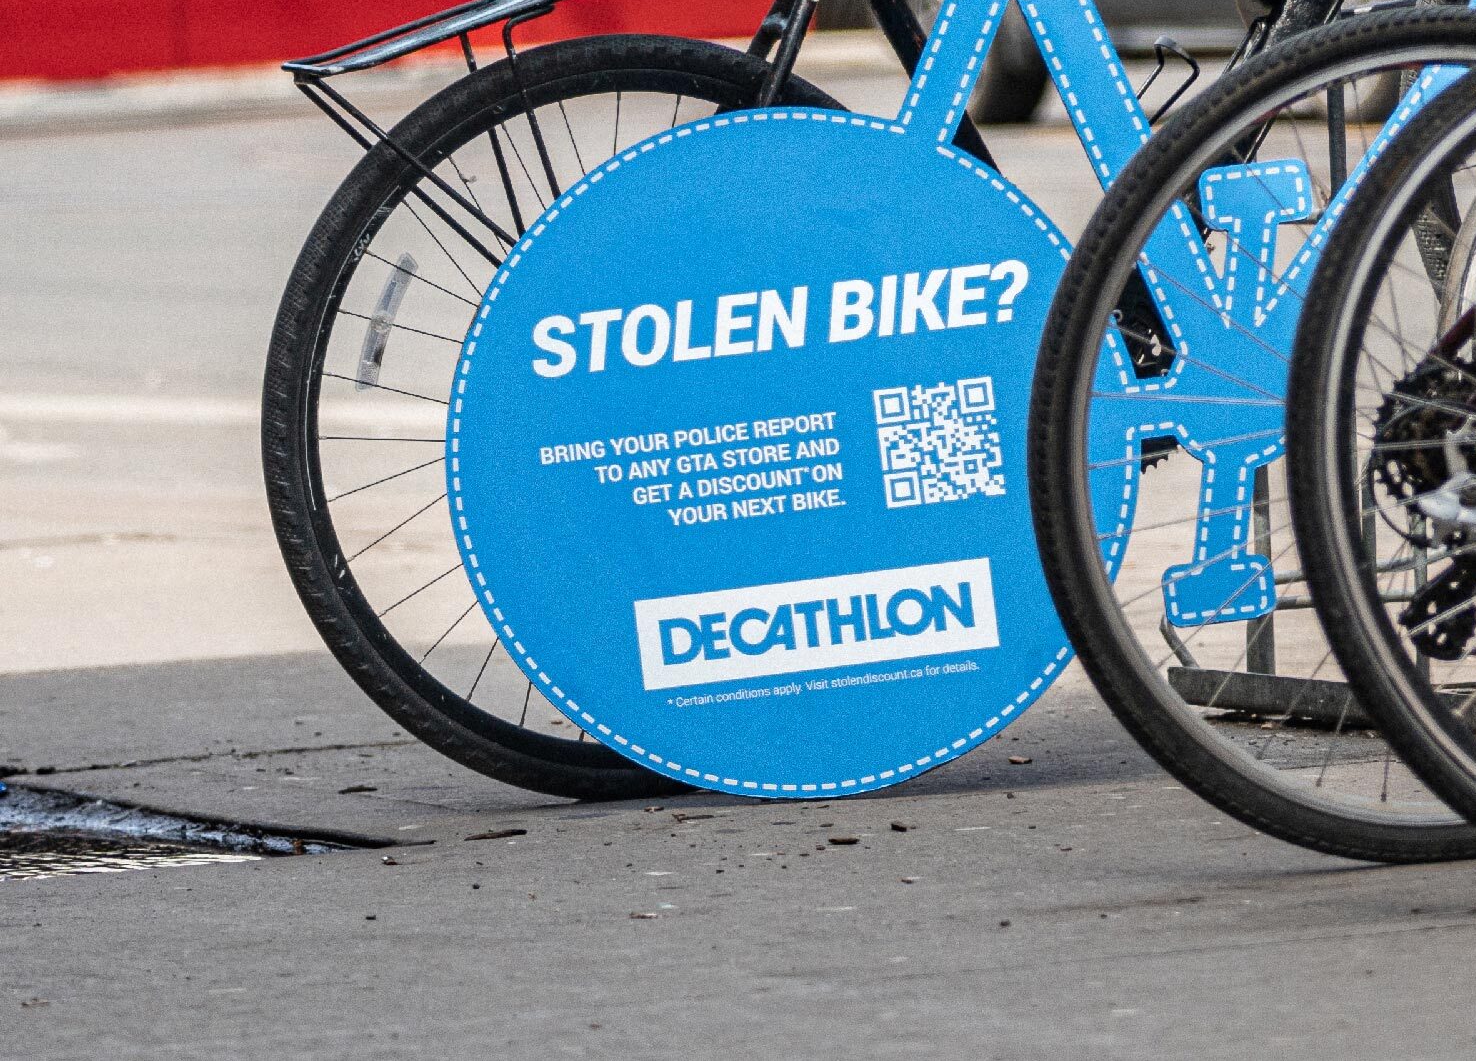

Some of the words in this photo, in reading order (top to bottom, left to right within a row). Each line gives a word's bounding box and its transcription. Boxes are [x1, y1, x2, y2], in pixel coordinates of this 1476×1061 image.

[531, 285, 808, 378] STOLEN
[828, 259, 1029, 342] BIKE?
[539, 438, 605, 465] BRING
[608, 431, 669, 456] YOUR
[674, 420, 750, 449] POLICE
[753, 411, 837, 439] REPORT
[594, 464, 622, 484] TO
[628, 457, 672, 480] ANY
[676, 451, 718, 475] GTA
[721, 443, 792, 469] STORE
[795, 437, 840, 460] AND
[632, 483, 672, 506] GET
[678, 481, 693, 500] A
[811, 462, 843, 483] ON
[667, 500, 728, 526] YOUR
[731, 494, 787, 519] NEXT
[791, 488, 847, 512] BIKE.
[658, 580, 976, 666] DECATHLON
[675, 693, 714, 707] Certain
[715, 688, 771, 703] conditions
[773, 682, 803, 697] apply.
[805, 678, 829, 691] Visit
[831, 668, 923, 688] stolendiscount.ca
[925, 664, 941, 676] for
[942, 659, 980, 674] details.
